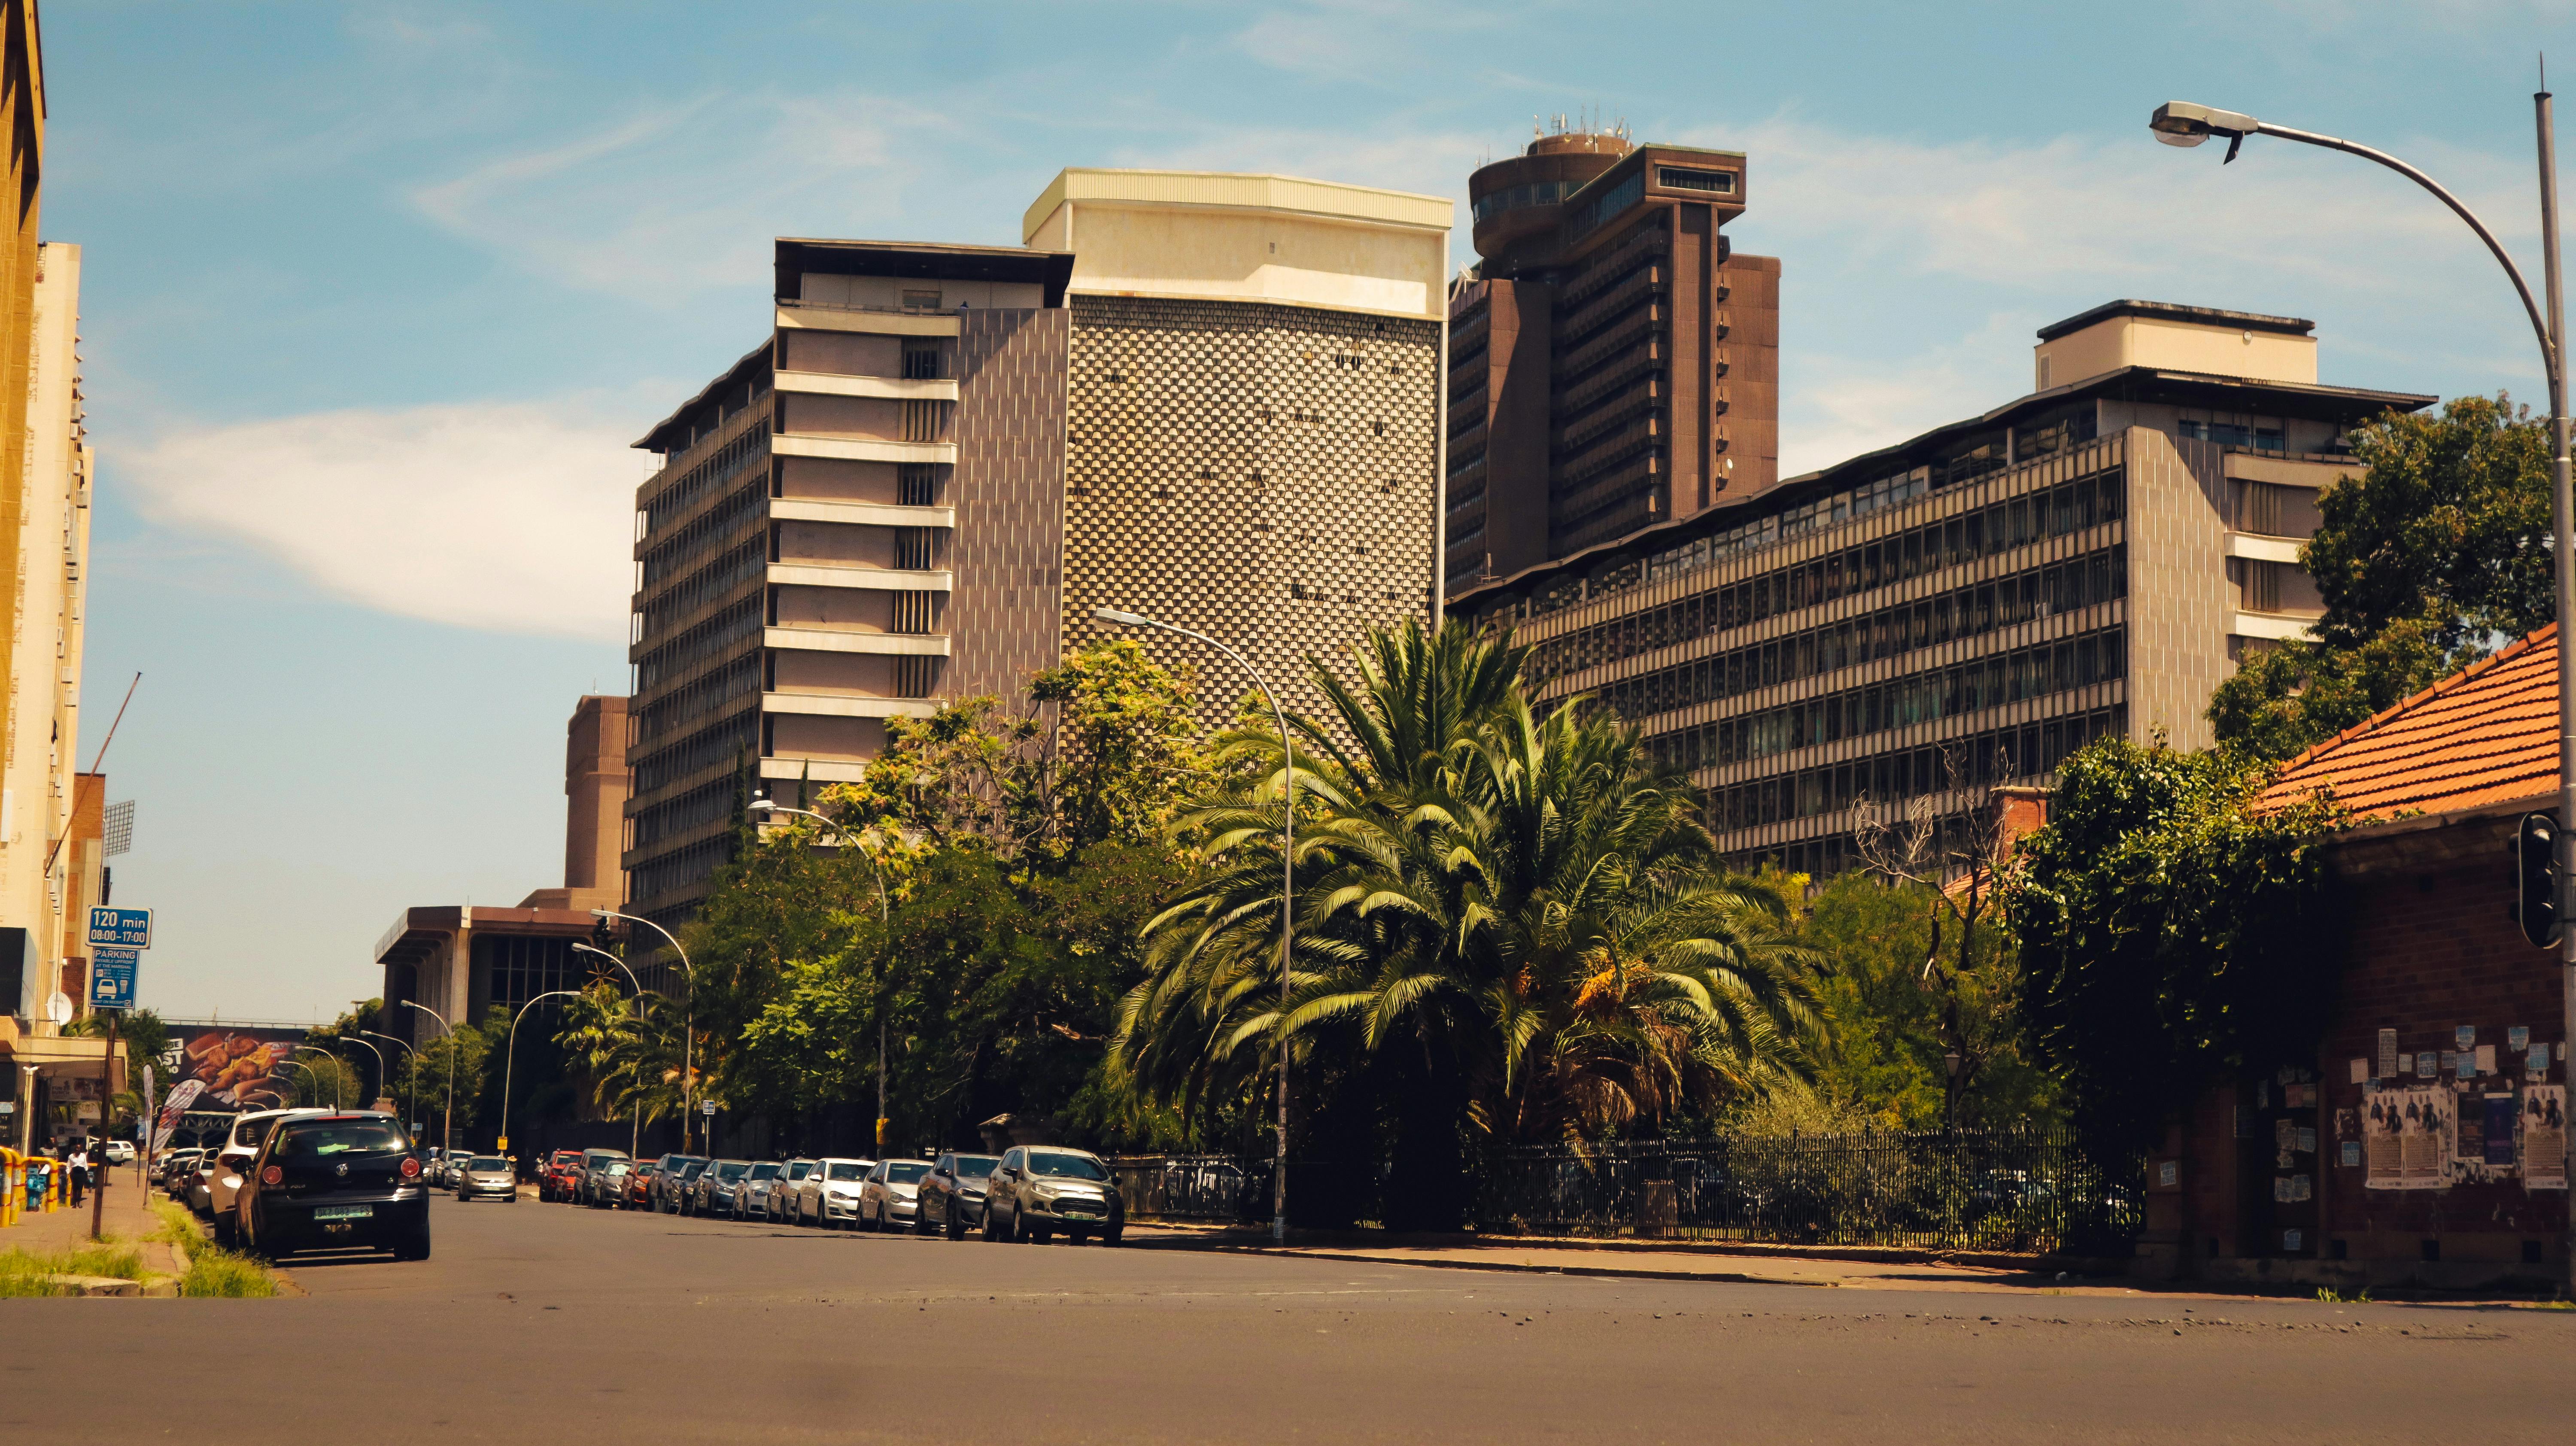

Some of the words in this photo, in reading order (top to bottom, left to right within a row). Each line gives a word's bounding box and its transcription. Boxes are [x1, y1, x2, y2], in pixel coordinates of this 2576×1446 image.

[94, 911, 117, 927] 120
[122, 917, 146, 928] min
[95, 950, 135, 960] PARKING
[360, 1206, 370, 1215] FS
